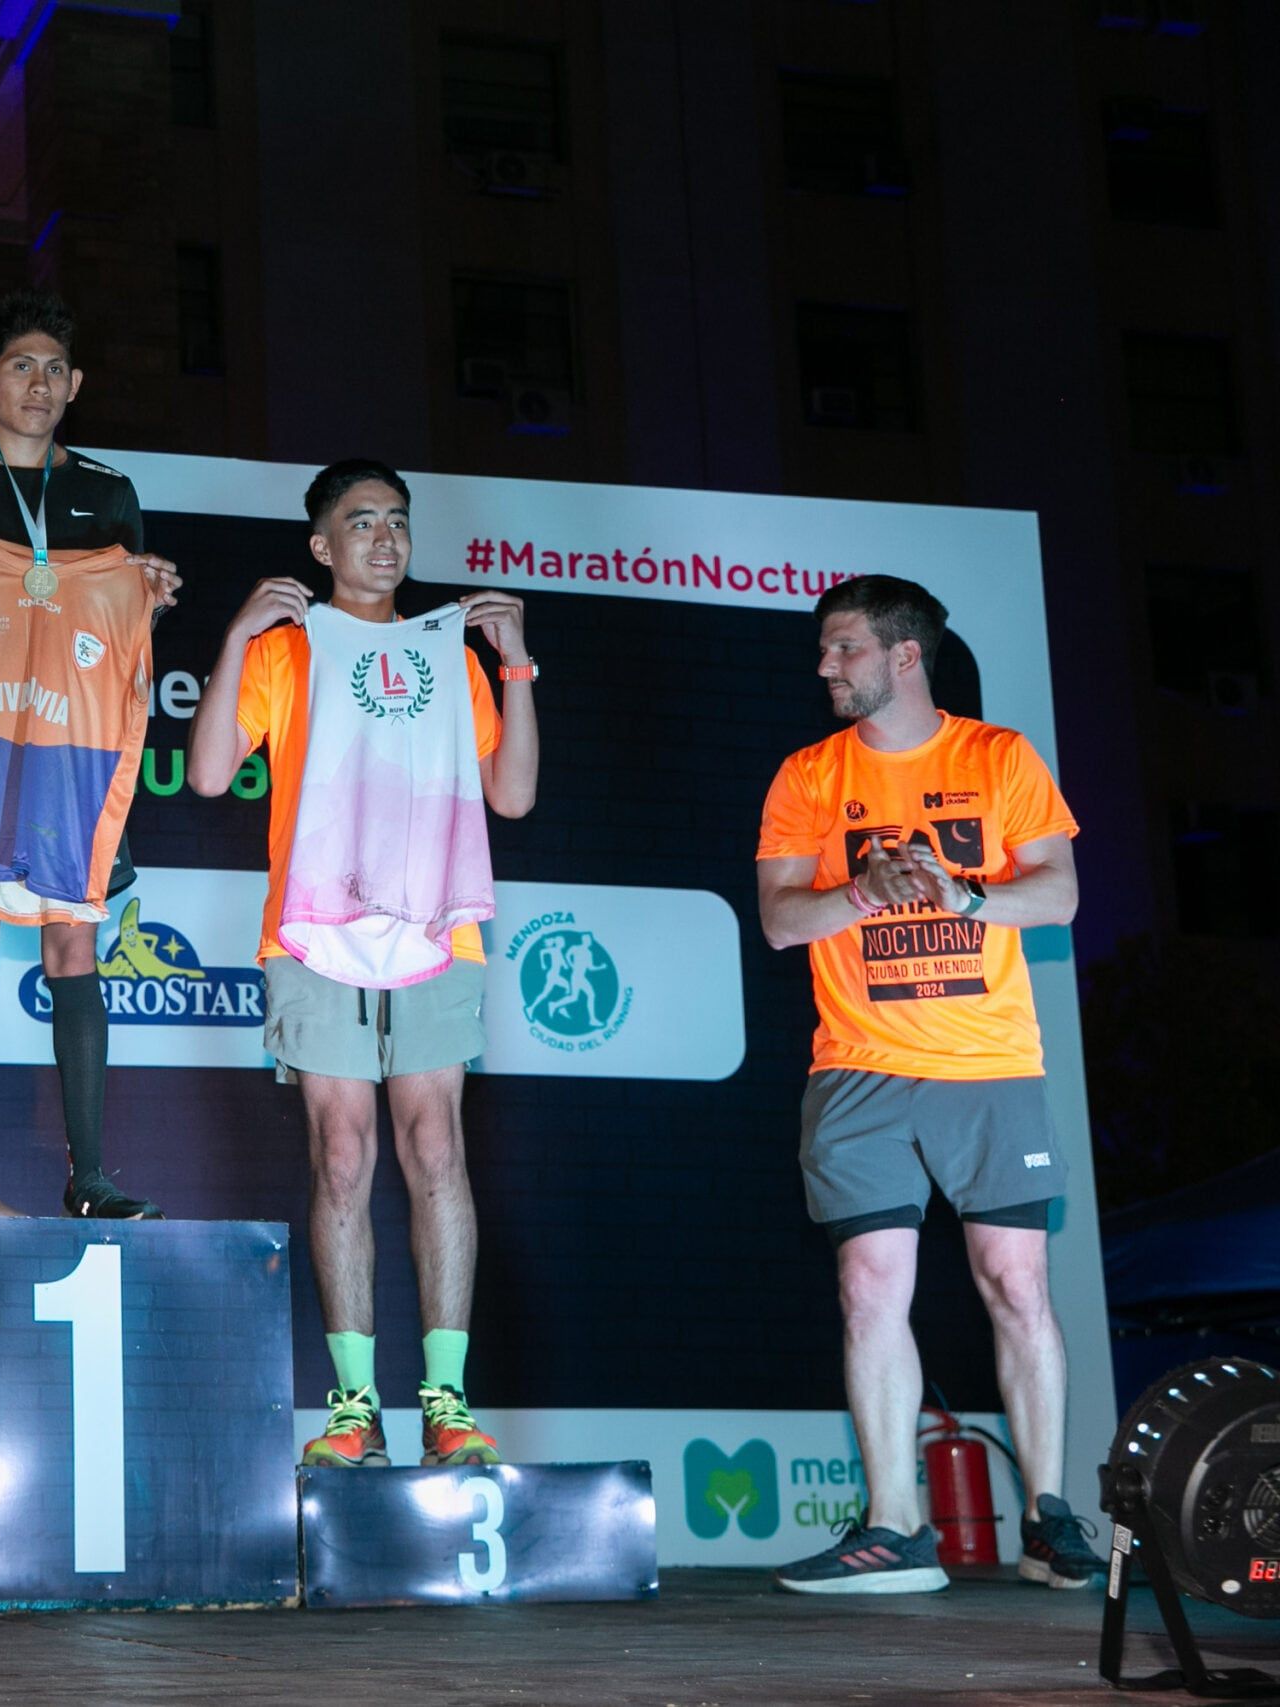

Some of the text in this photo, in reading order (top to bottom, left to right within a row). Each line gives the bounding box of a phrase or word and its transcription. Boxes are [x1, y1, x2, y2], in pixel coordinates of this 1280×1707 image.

[505, 911, 575, 961] MENDOZA
[865, 922, 982, 957] NOCTURNA
[913, 962, 929, 976] DE
[916, 983, 945, 997] 2024
[529, 986, 633, 1052] CIUDAD DEL RUNNING
[34, 1244, 126, 1573] 1
[458, 1476, 507, 1593] 3
